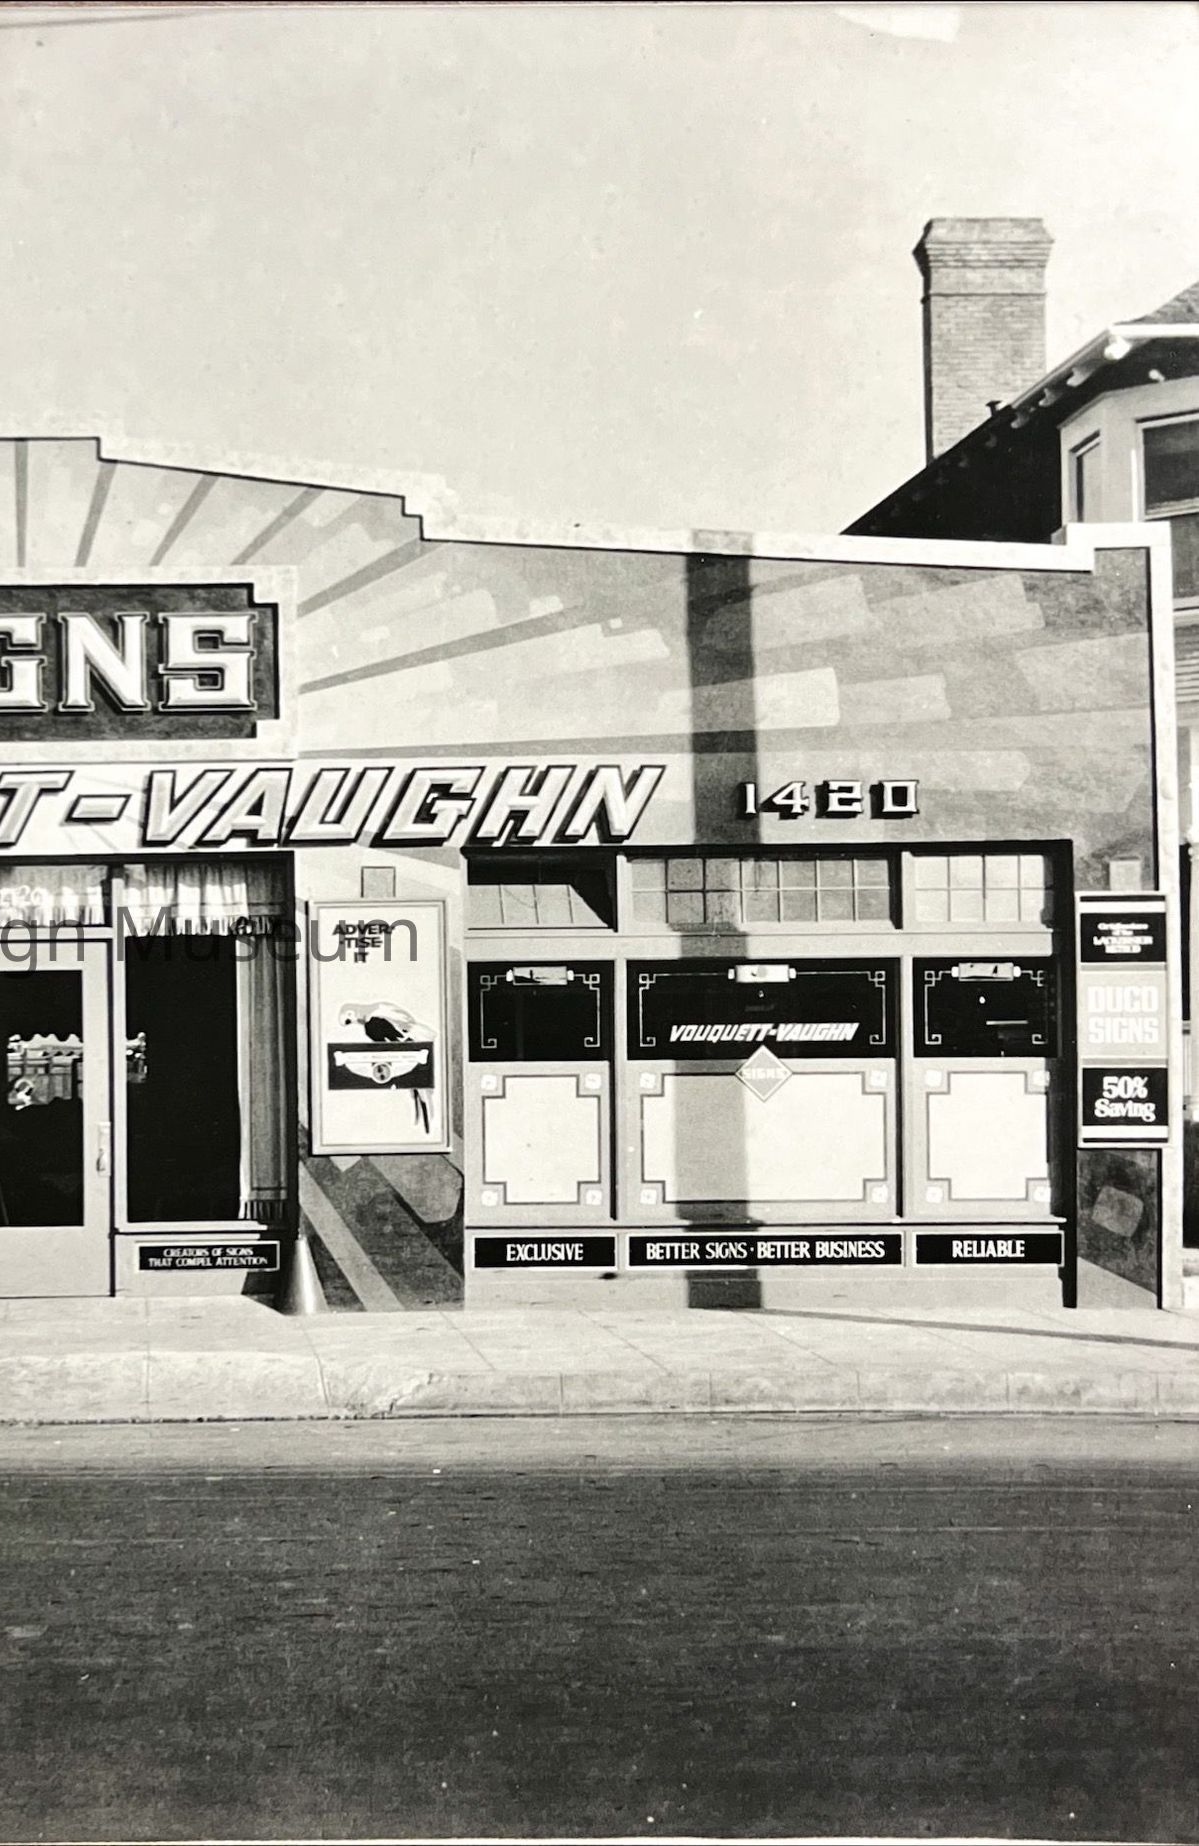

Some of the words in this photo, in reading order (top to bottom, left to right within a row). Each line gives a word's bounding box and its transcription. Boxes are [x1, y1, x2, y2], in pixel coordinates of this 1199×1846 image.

[740, 780, 919, 820] 1420
[354, 952, 369, 963] IT
[1087, 985, 1159, 1012] DUCO
[669, 1023, 860, 1043] VOUQUETT-VAUGHN
[1088, 1017, 1159, 1043] SIGNS
[1102, 1076, 1148, 1099] 50%
[1094, 1098, 1156, 1122] Saving
[163, 1248, 210, 1257] CREATORS
[211, 1247, 224, 1257] OF
[226, 1247, 254, 1256] SIGNS
[506, 1243, 585, 1261] EXCLUSIVE
[646, 1242, 701, 1260] BETTER
[757, 1241, 811, 1259] BETTER
[815, 1240, 886, 1259] BUSINESS
[952, 1239, 1026, 1258] RELIABLE
[148, 1258, 172, 1267] THAT
[175, 1257, 213, 1267] COMPEL
[215, 1256, 268, 1266] ATTENTION
